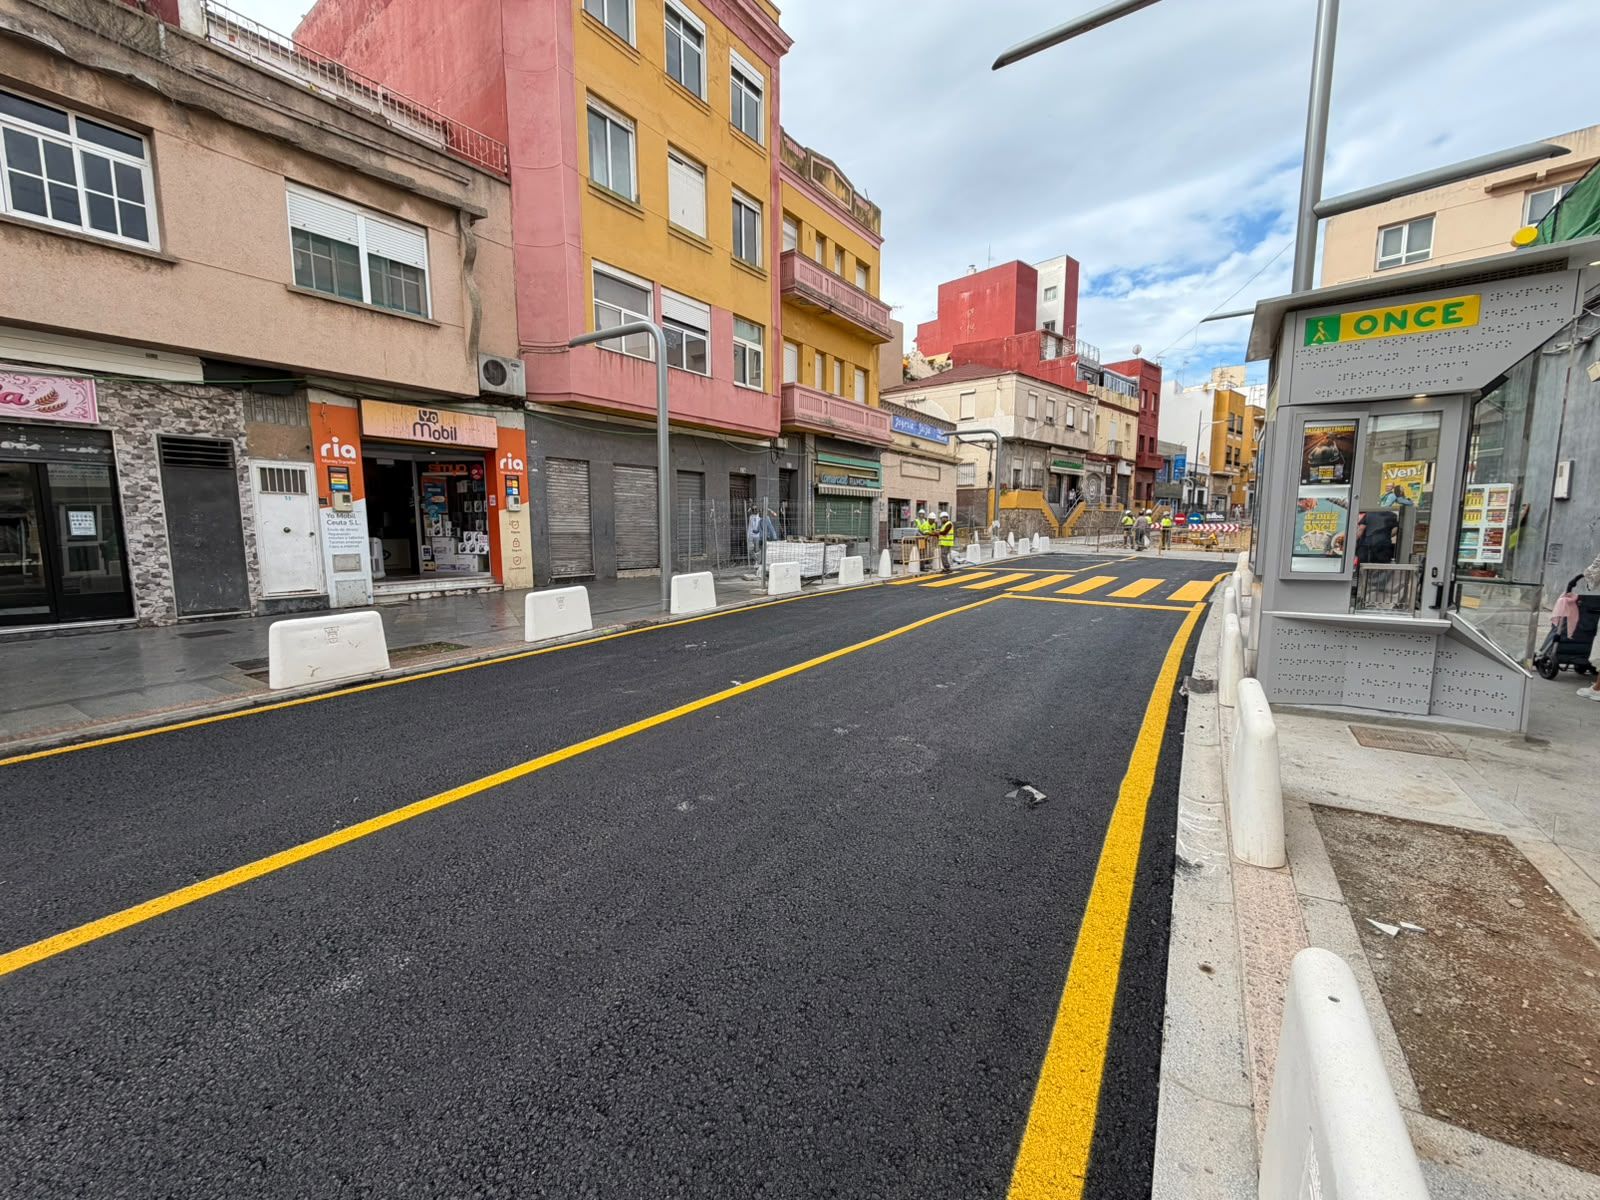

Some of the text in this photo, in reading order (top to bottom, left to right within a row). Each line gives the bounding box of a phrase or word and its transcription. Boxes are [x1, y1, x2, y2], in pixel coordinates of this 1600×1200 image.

[1353, 301, 1465, 336] ONCE
[320, 436, 357, 459] ria
[499, 452, 524, 471] ria
[1383, 465, 1422, 480] ¡Ven!
[1303, 523, 1337, 532] ONCE
